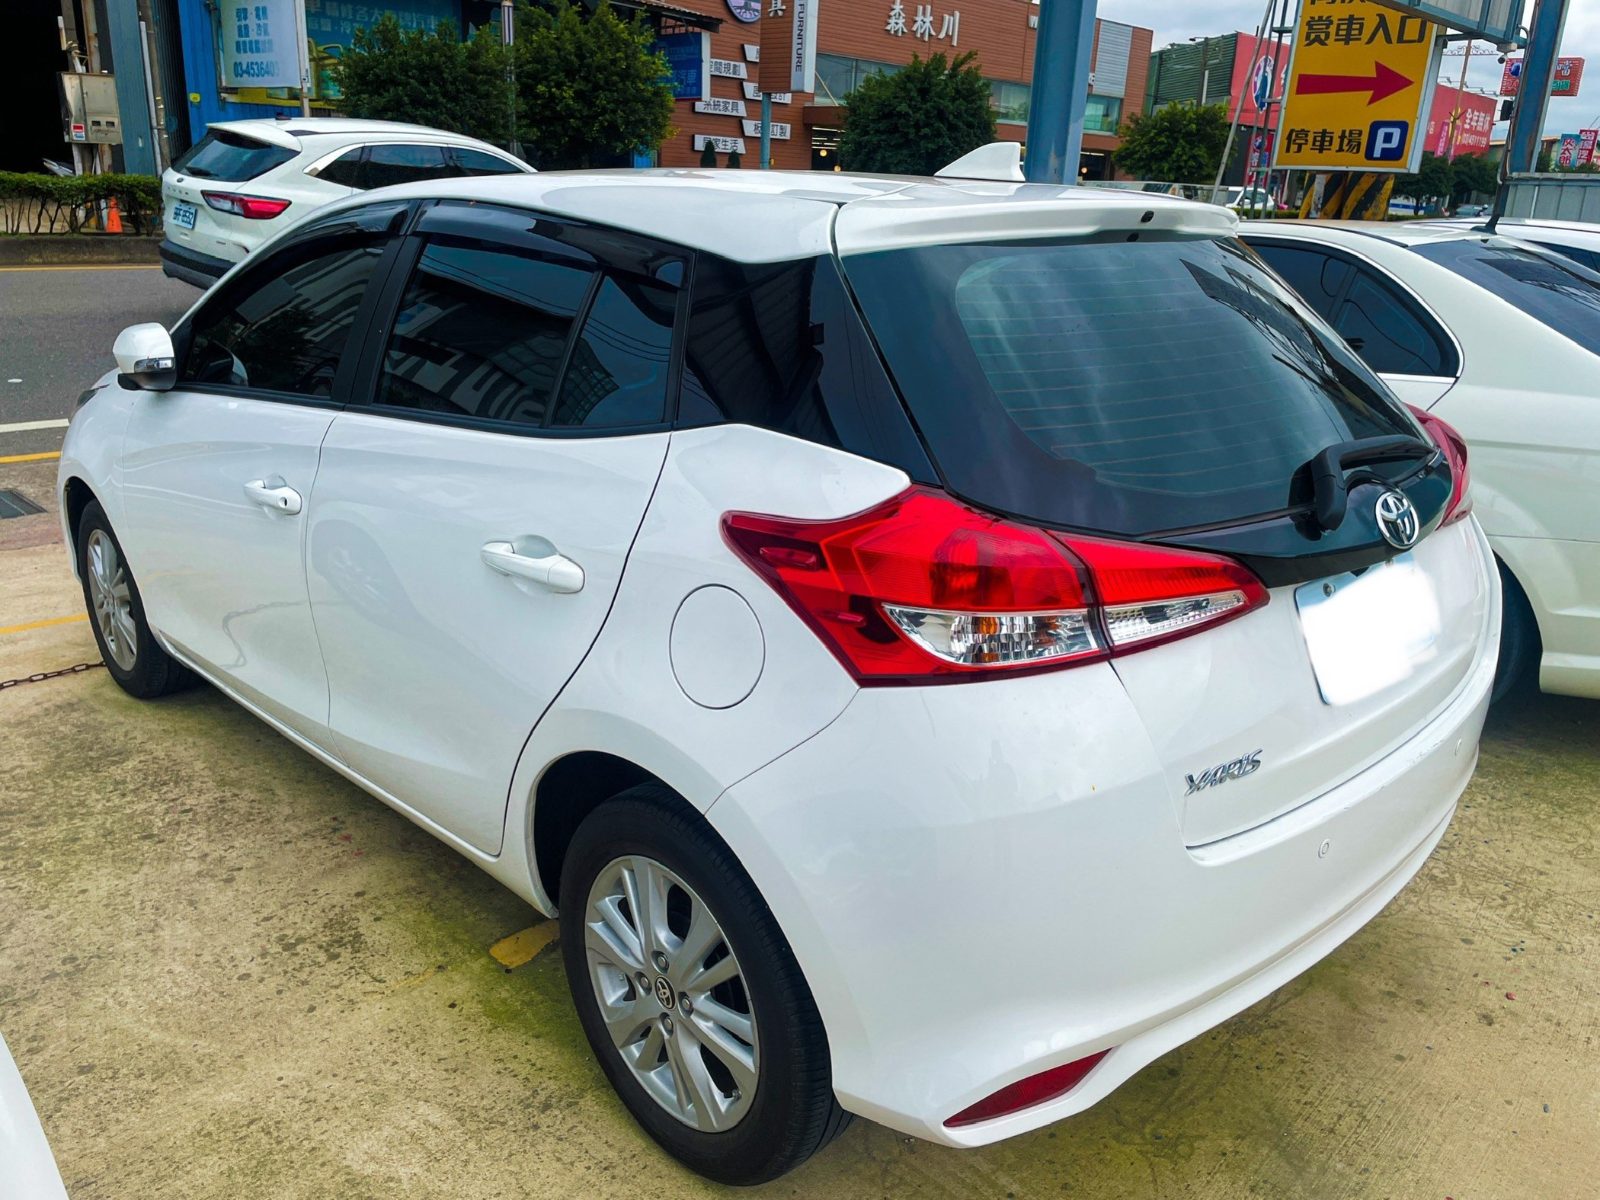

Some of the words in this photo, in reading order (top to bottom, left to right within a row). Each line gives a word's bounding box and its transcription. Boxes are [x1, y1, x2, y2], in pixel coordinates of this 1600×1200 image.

[795, 3, 805, 73] FURNITURE
[884, 0, 960, 47] 森林川
[1285, 128, 1363, 154] 停車場
[1184, 748, 1263, 796] YARIS
